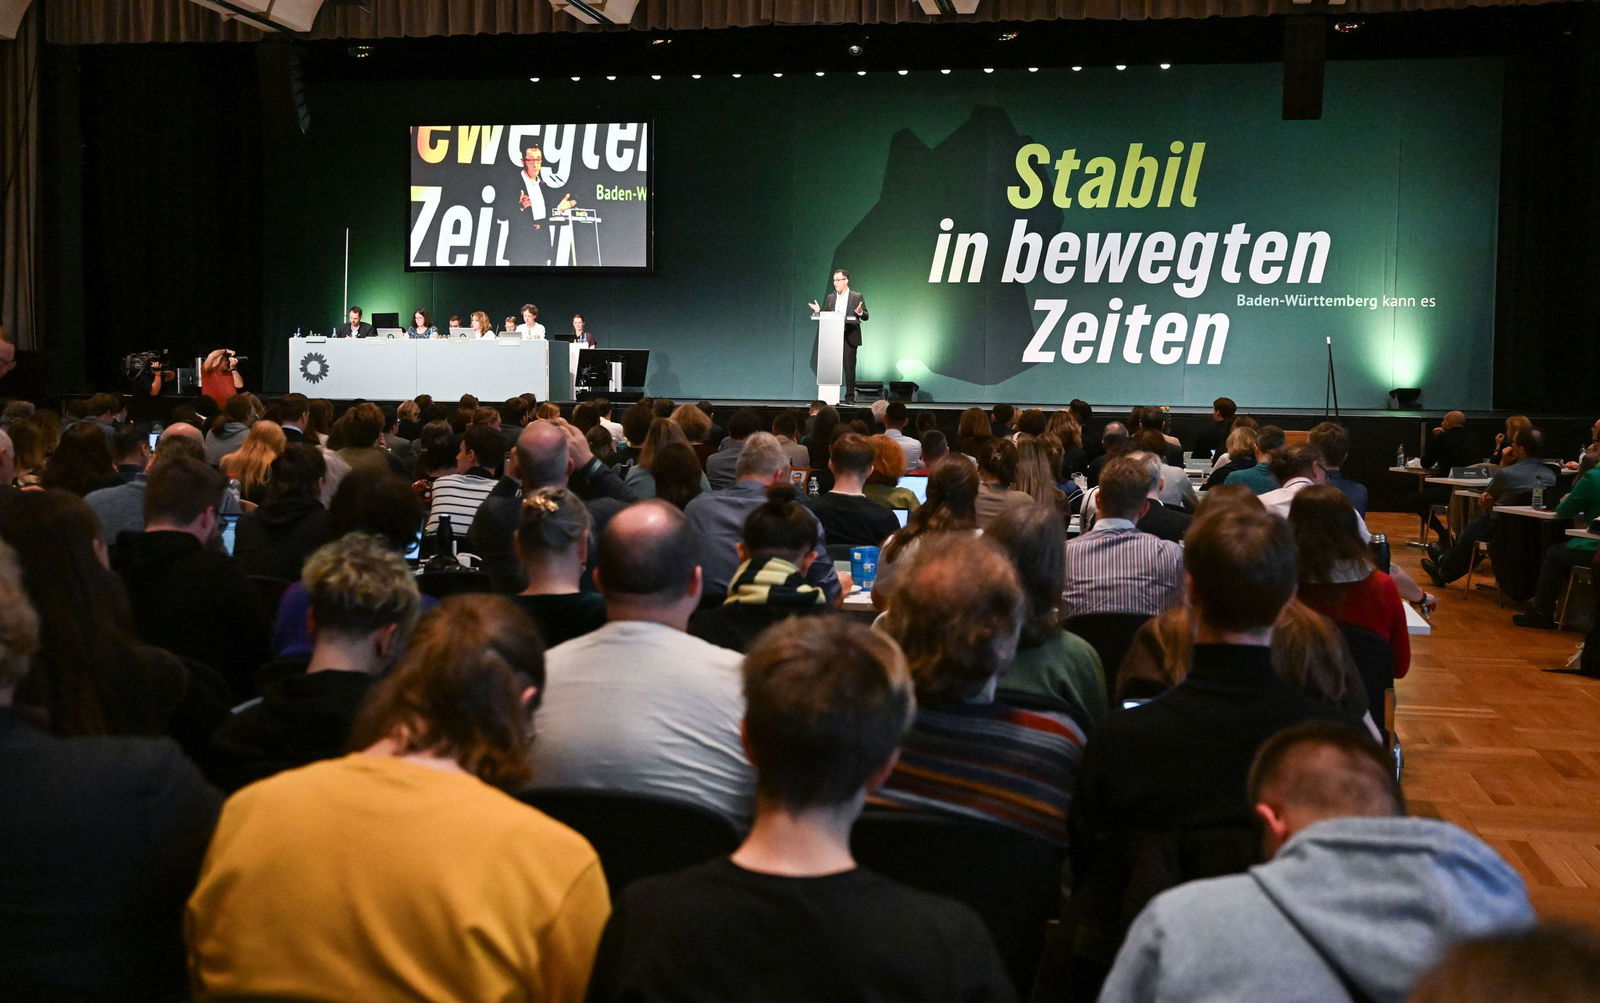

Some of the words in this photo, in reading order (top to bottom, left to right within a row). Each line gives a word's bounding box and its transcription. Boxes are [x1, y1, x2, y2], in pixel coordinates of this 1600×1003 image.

[1007, 140, 1206, 209] Stabil
[927, 217, 989, 284] in
[1001, 218, 1331, 299] bewegten
[1021, 297, 1230, 366] Zeiten
[1236, 293, 1378, 310] Baden-Württemberg
[1382, 293, 1416, 308] kann
[1420, 297, 1436, 308] es
